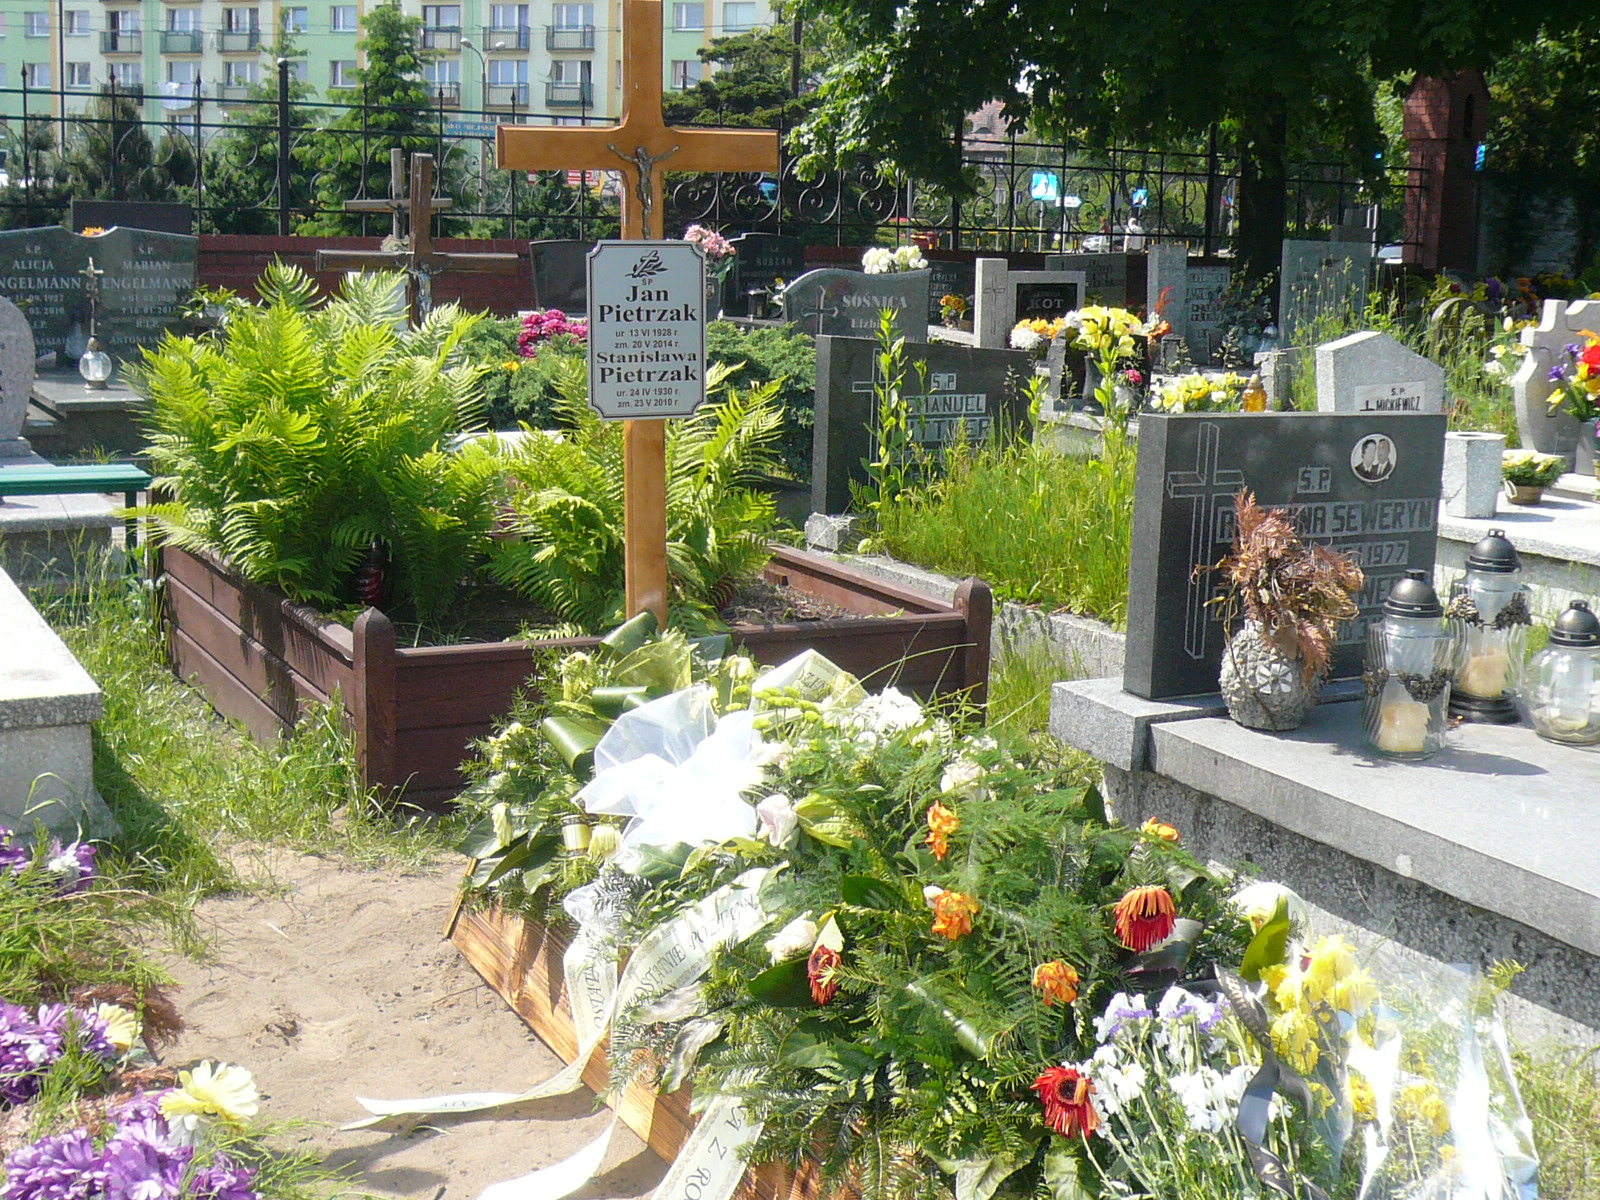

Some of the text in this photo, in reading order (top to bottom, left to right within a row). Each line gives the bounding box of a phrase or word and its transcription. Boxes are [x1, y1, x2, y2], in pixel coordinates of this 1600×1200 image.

[12, 259, 55, 271] ALICJA
[123, 260, 171, 271] MARIAN
[102, 277, 192, 290] ENGELMANN
[625, 285, 669, 302] Jan
[841, 292, 908, 309] SOŚNICA
[1028, 298, 1065, 309] KOT
[598, 303, 697, 323] Pietrzak
[630, 329, 639, 337] 13
[640, 329, 650, 337] VI
[653, 328, 672, 337] 1928
[632, 341, 642, 349] 20
[644, 340, 651, 348] V
[653, 340, 673, 348] 2014
[599, 365, 698, 384] Pietrzak
[629, 388, 640, 396] 24
[642, 388, 651, 396] IV
[654, 387, 673, 395] 1930
[634, 399, 644, 407] 23
[645, 398, 652, 407] V
[654, 398, 673, 406] 2010
[1375, 396, 1421, 411] MICKIEWICZ
[1331, 500, 1434, 532] SEWERYN
[632, 944, 688, 1002] OSTATNIE
[707, 1136, 728, 1160] Z
